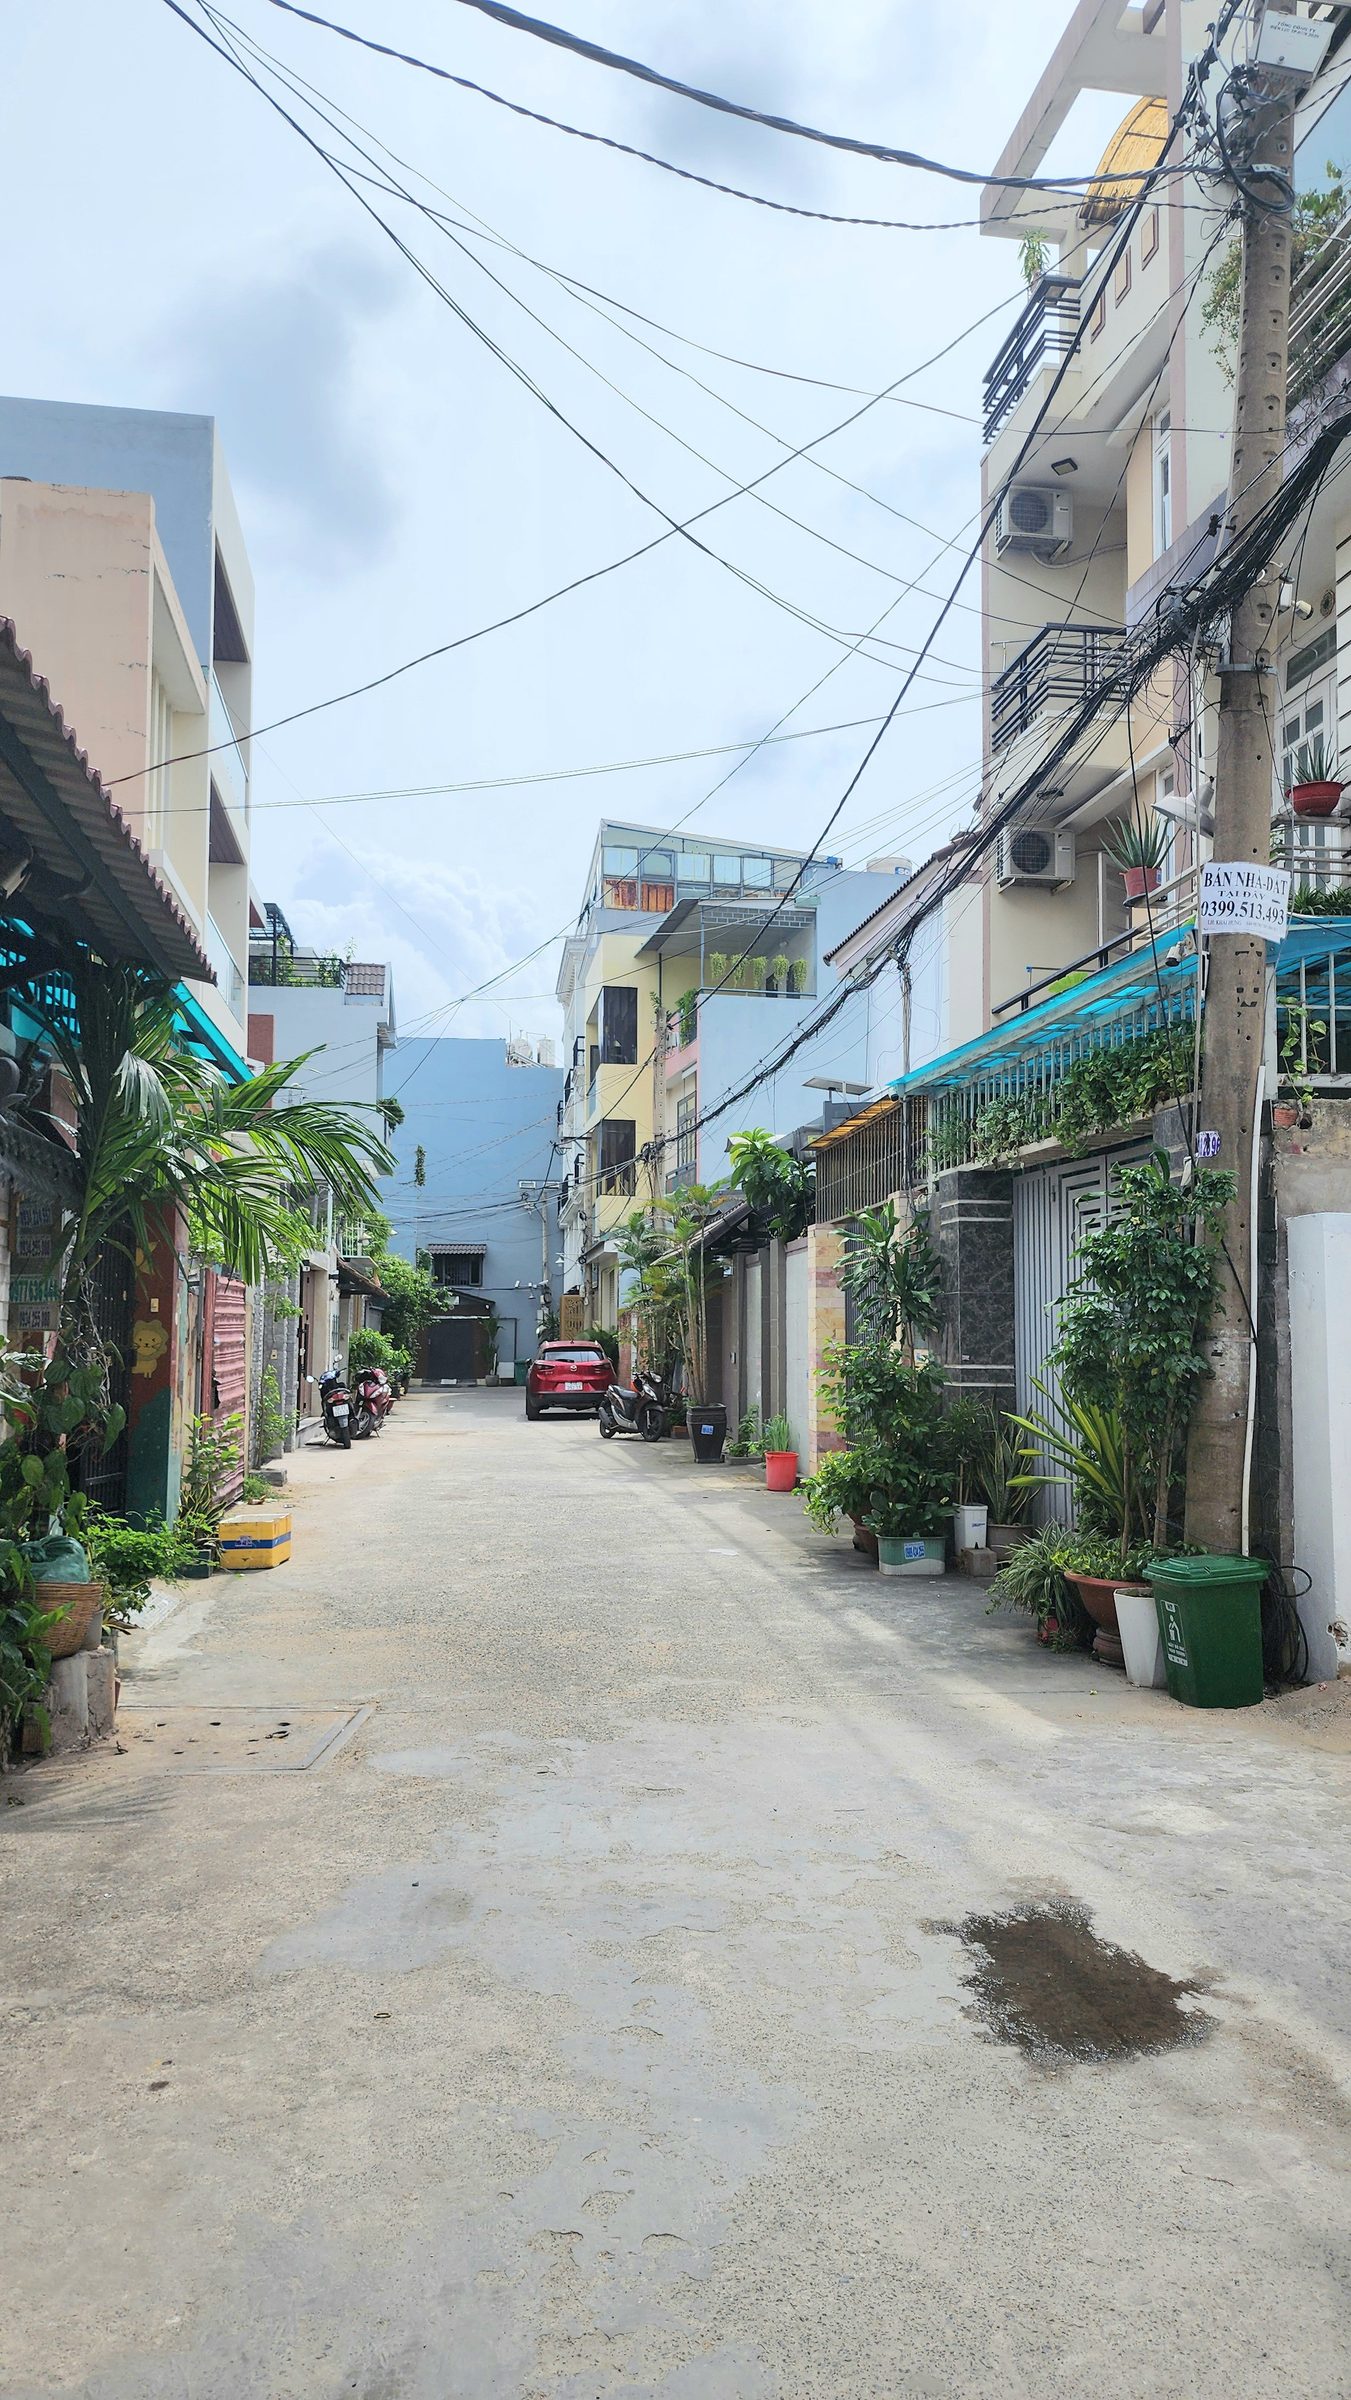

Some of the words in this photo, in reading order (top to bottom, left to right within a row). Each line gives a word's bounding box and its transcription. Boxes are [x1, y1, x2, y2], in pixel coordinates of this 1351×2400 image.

[1204, 867, 1233, 888] BÁN
[1243, 891, 1266, 900] ĐÂY
[1201, 900, 1285, 926] 0399.513.493
